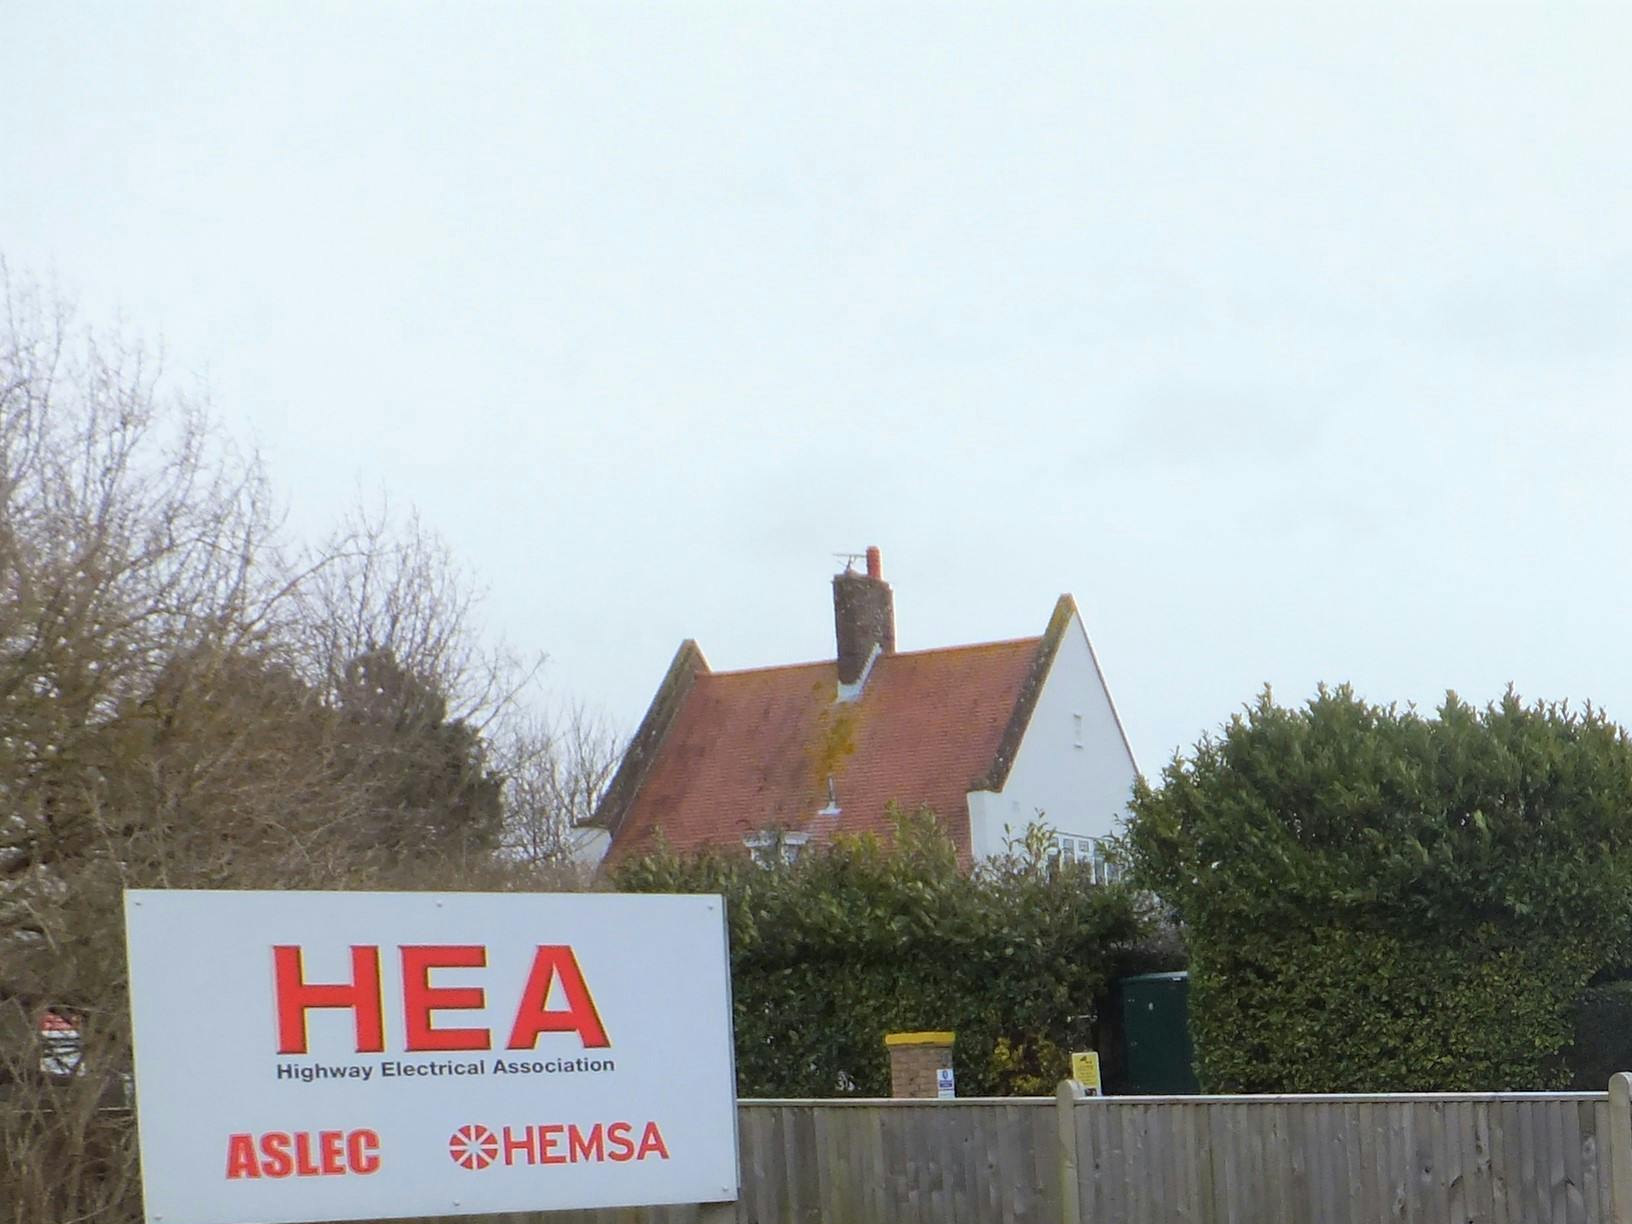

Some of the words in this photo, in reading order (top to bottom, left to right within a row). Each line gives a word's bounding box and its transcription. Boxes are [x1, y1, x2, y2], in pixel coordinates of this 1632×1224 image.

[272, 943, 613, 1055] HEA
[276, 1063, 373, 1083] Highway
[381, 1060, 485, 1078] Electrical
[492, 1057, 616, 1075] Association
[226, 1128, 382, 1180] ASLEC
[502, 1121, 670, 1166] HEMSA
